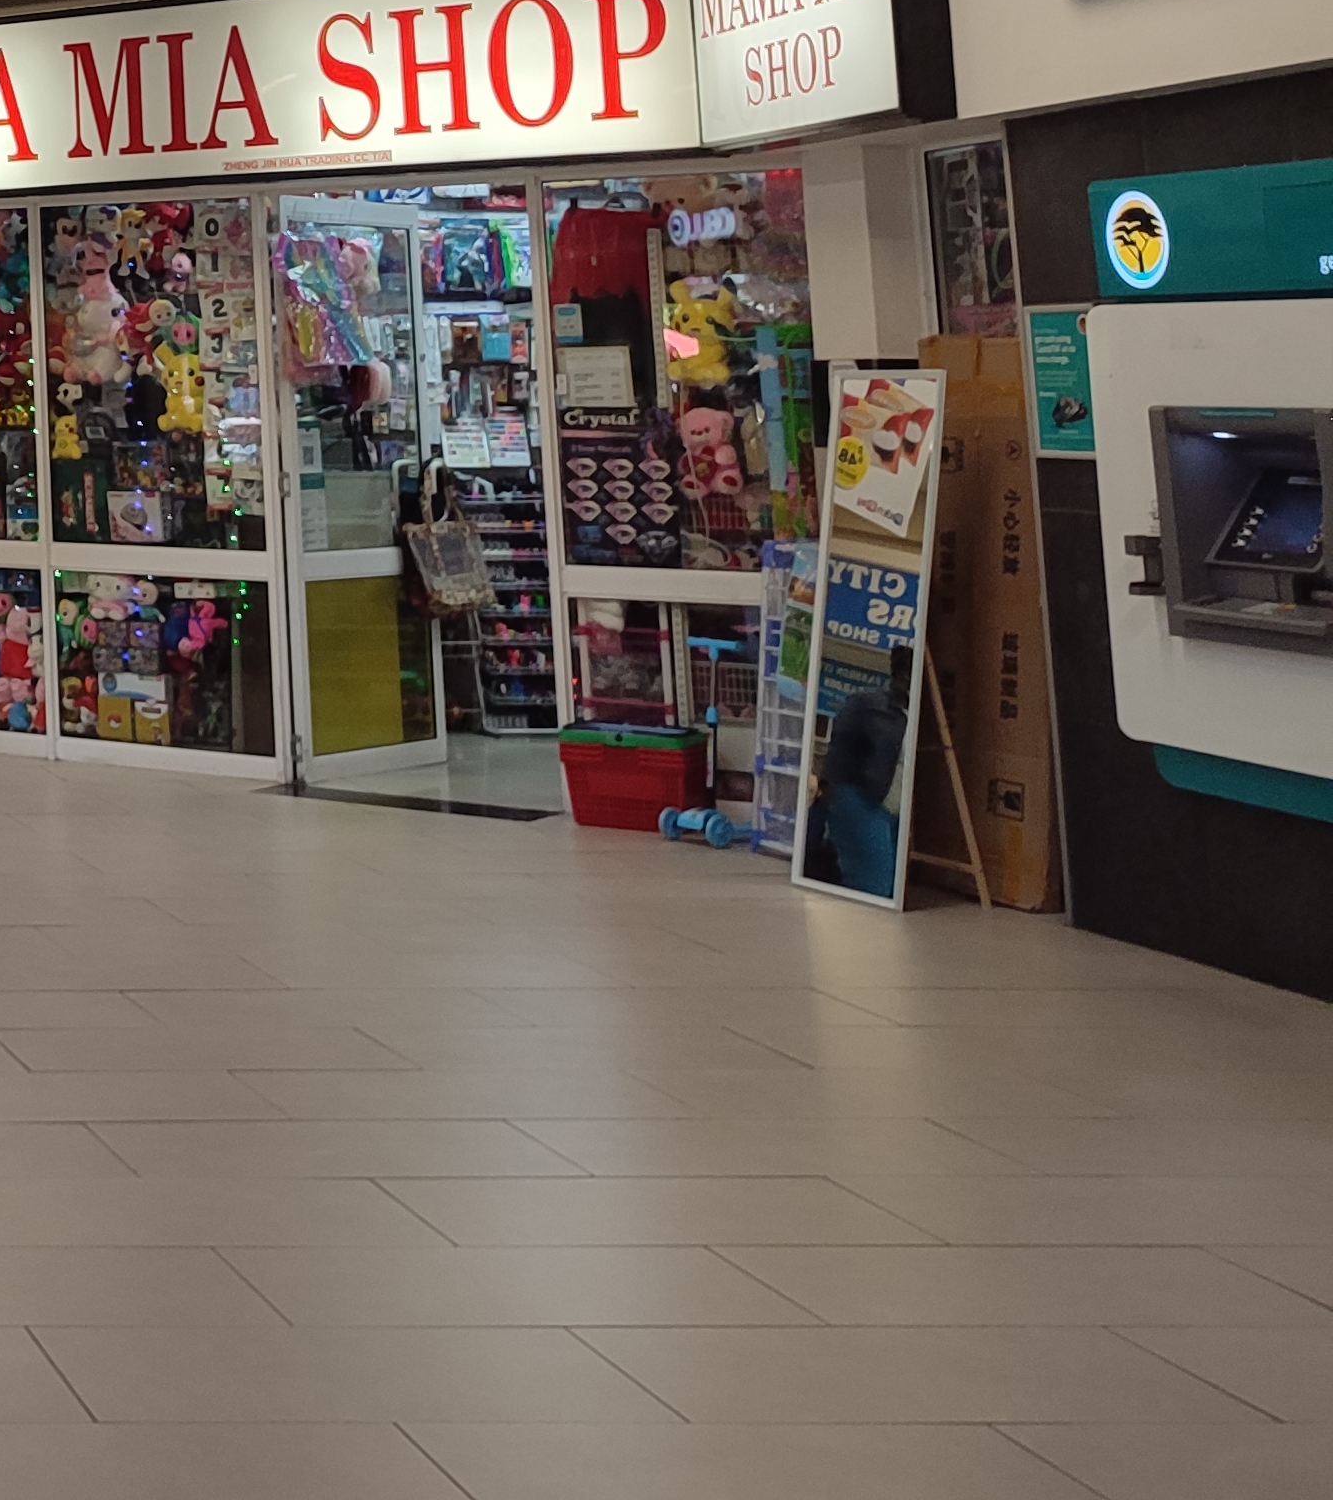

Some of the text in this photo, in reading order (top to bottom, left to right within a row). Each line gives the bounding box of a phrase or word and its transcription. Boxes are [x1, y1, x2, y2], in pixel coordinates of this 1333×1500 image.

[744, 25, 843, 107] SHOP
[64, 24, 279, 159] MIA
[223, 159, 259, 172] ZHENG
[260, 158, 277, 169] JIN
[279, 156, 302, 168] HUA
[304, 154, 351, 167] TRADING
[353, 153, 369, 162] CC
[204, 217, 219, 238] 0
[210, 298, 228, 319] 2
[209, 333, 224, 355] 3
